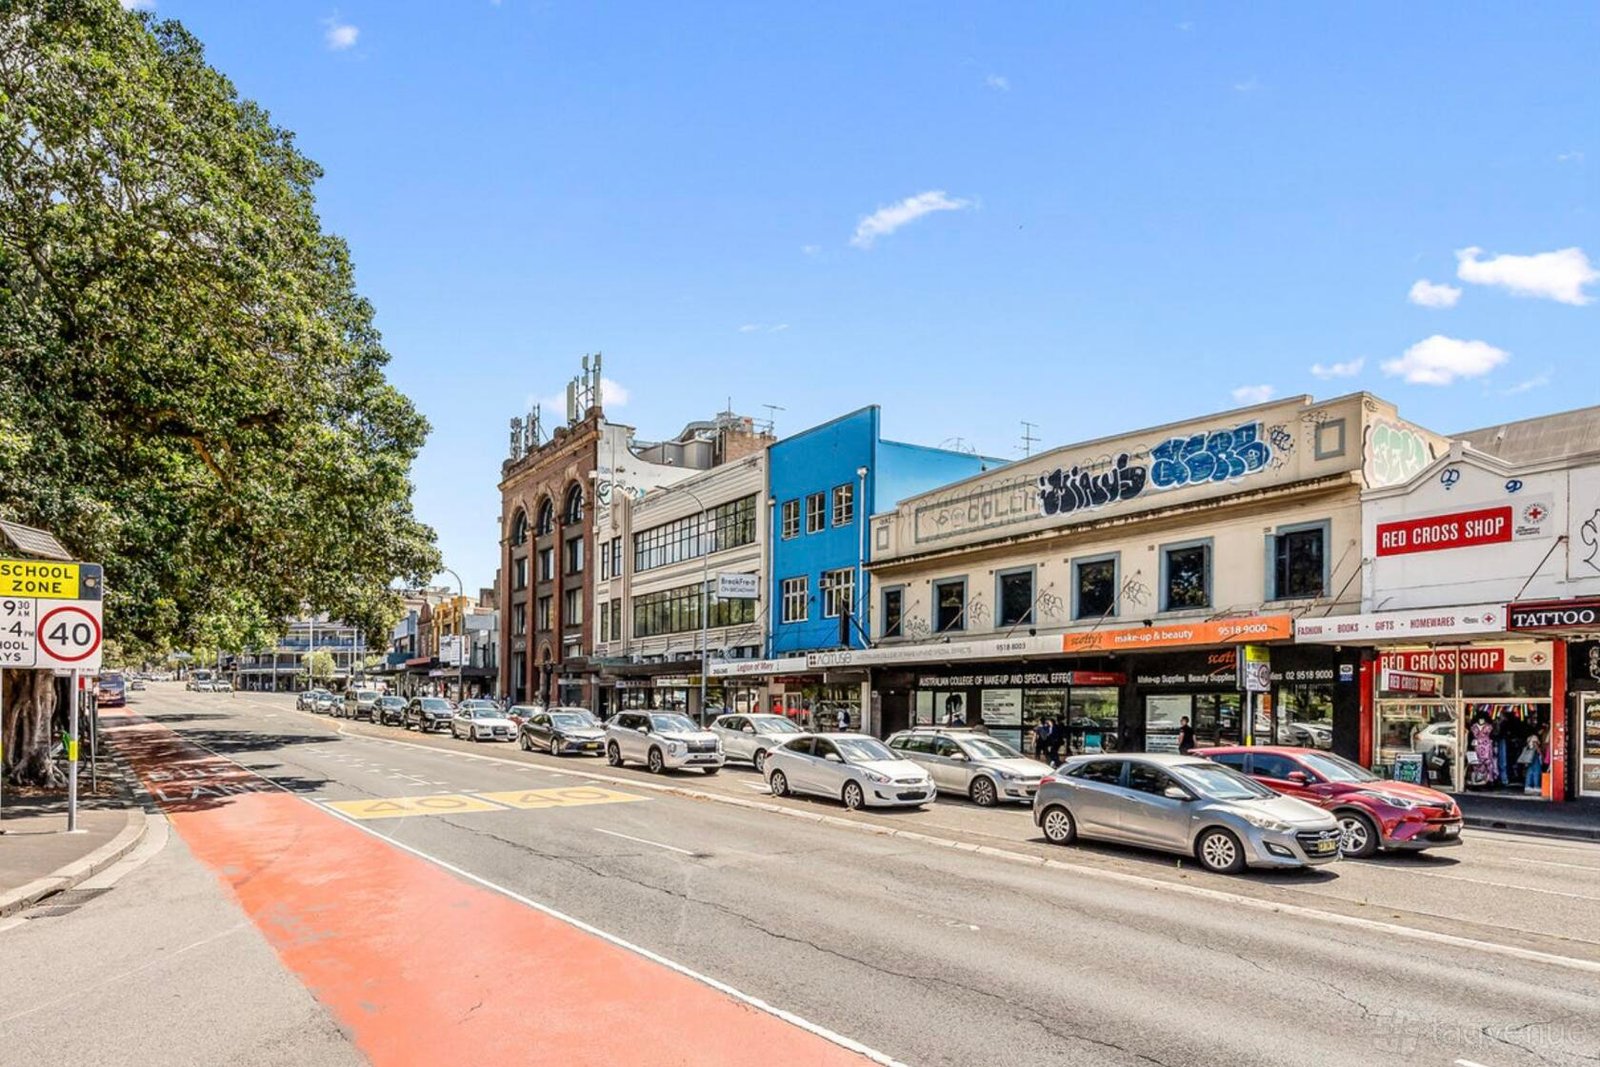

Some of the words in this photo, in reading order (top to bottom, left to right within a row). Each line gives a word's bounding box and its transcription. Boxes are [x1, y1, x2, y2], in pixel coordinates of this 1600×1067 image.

[1382, 530, 1407, 549] RED
[1412, 523, 1459, 545] CROSS
[1464, 517, 1505, 539] SHOP
[1, 564, 74, 579] SCHOOL
[12, 580, 62, 593] ZONE
[1513, 609, 1595, 627] TATTOO
[1297, 625, 1323, 636] FASHION
[1337, 623, 1359, 634] BOOKS
[1374, 621, 1395, 631] GIFTS
[1410, 616, 1456, 630] HOMEWARES
[48, 622, 91, 646] 40
[1114, 633, 1152, 644] make-up
[1153, 631, 1161, 640] &
[1162, 629, 1194, 641] beauty
[0, 641, 29, 650] OOL
[996, 643, 1011, 651] 9518
[0, 652, 22, 662] YS
[1381, 655, 1405, 671] RED
[1411, 653, 1456, 671] CROSS
[1461, 651, 1499, 670] SHOP
[919, 676, 949, 687] AUSTRALIAN
[950, 675, 974, 686] COLLEGE
[975, 675, 983, 685] OF
[984, 674, 1009, 685] MAKE-UP
[1010, 674, 1023, 684] AND
[1024, 673, 1050, 684] SPECIAL
[1137, 675, 1161, 685] Make-up
[1162, 674, 1186, 684] Supplies
[1188, 674, 1209, 684] Beauty
[1210, 672, 1236, 683] Supplies
[1285, 671, 1295, 681] 02
[1296, 670, 1314, 680] 9518
[1315, 669, 1334, 680] 9000
[1389, 674, 1401, 689] RED
[1402, 676, 1419, 691] CROSS
[1420, 677, 1434, 692] SHOP
